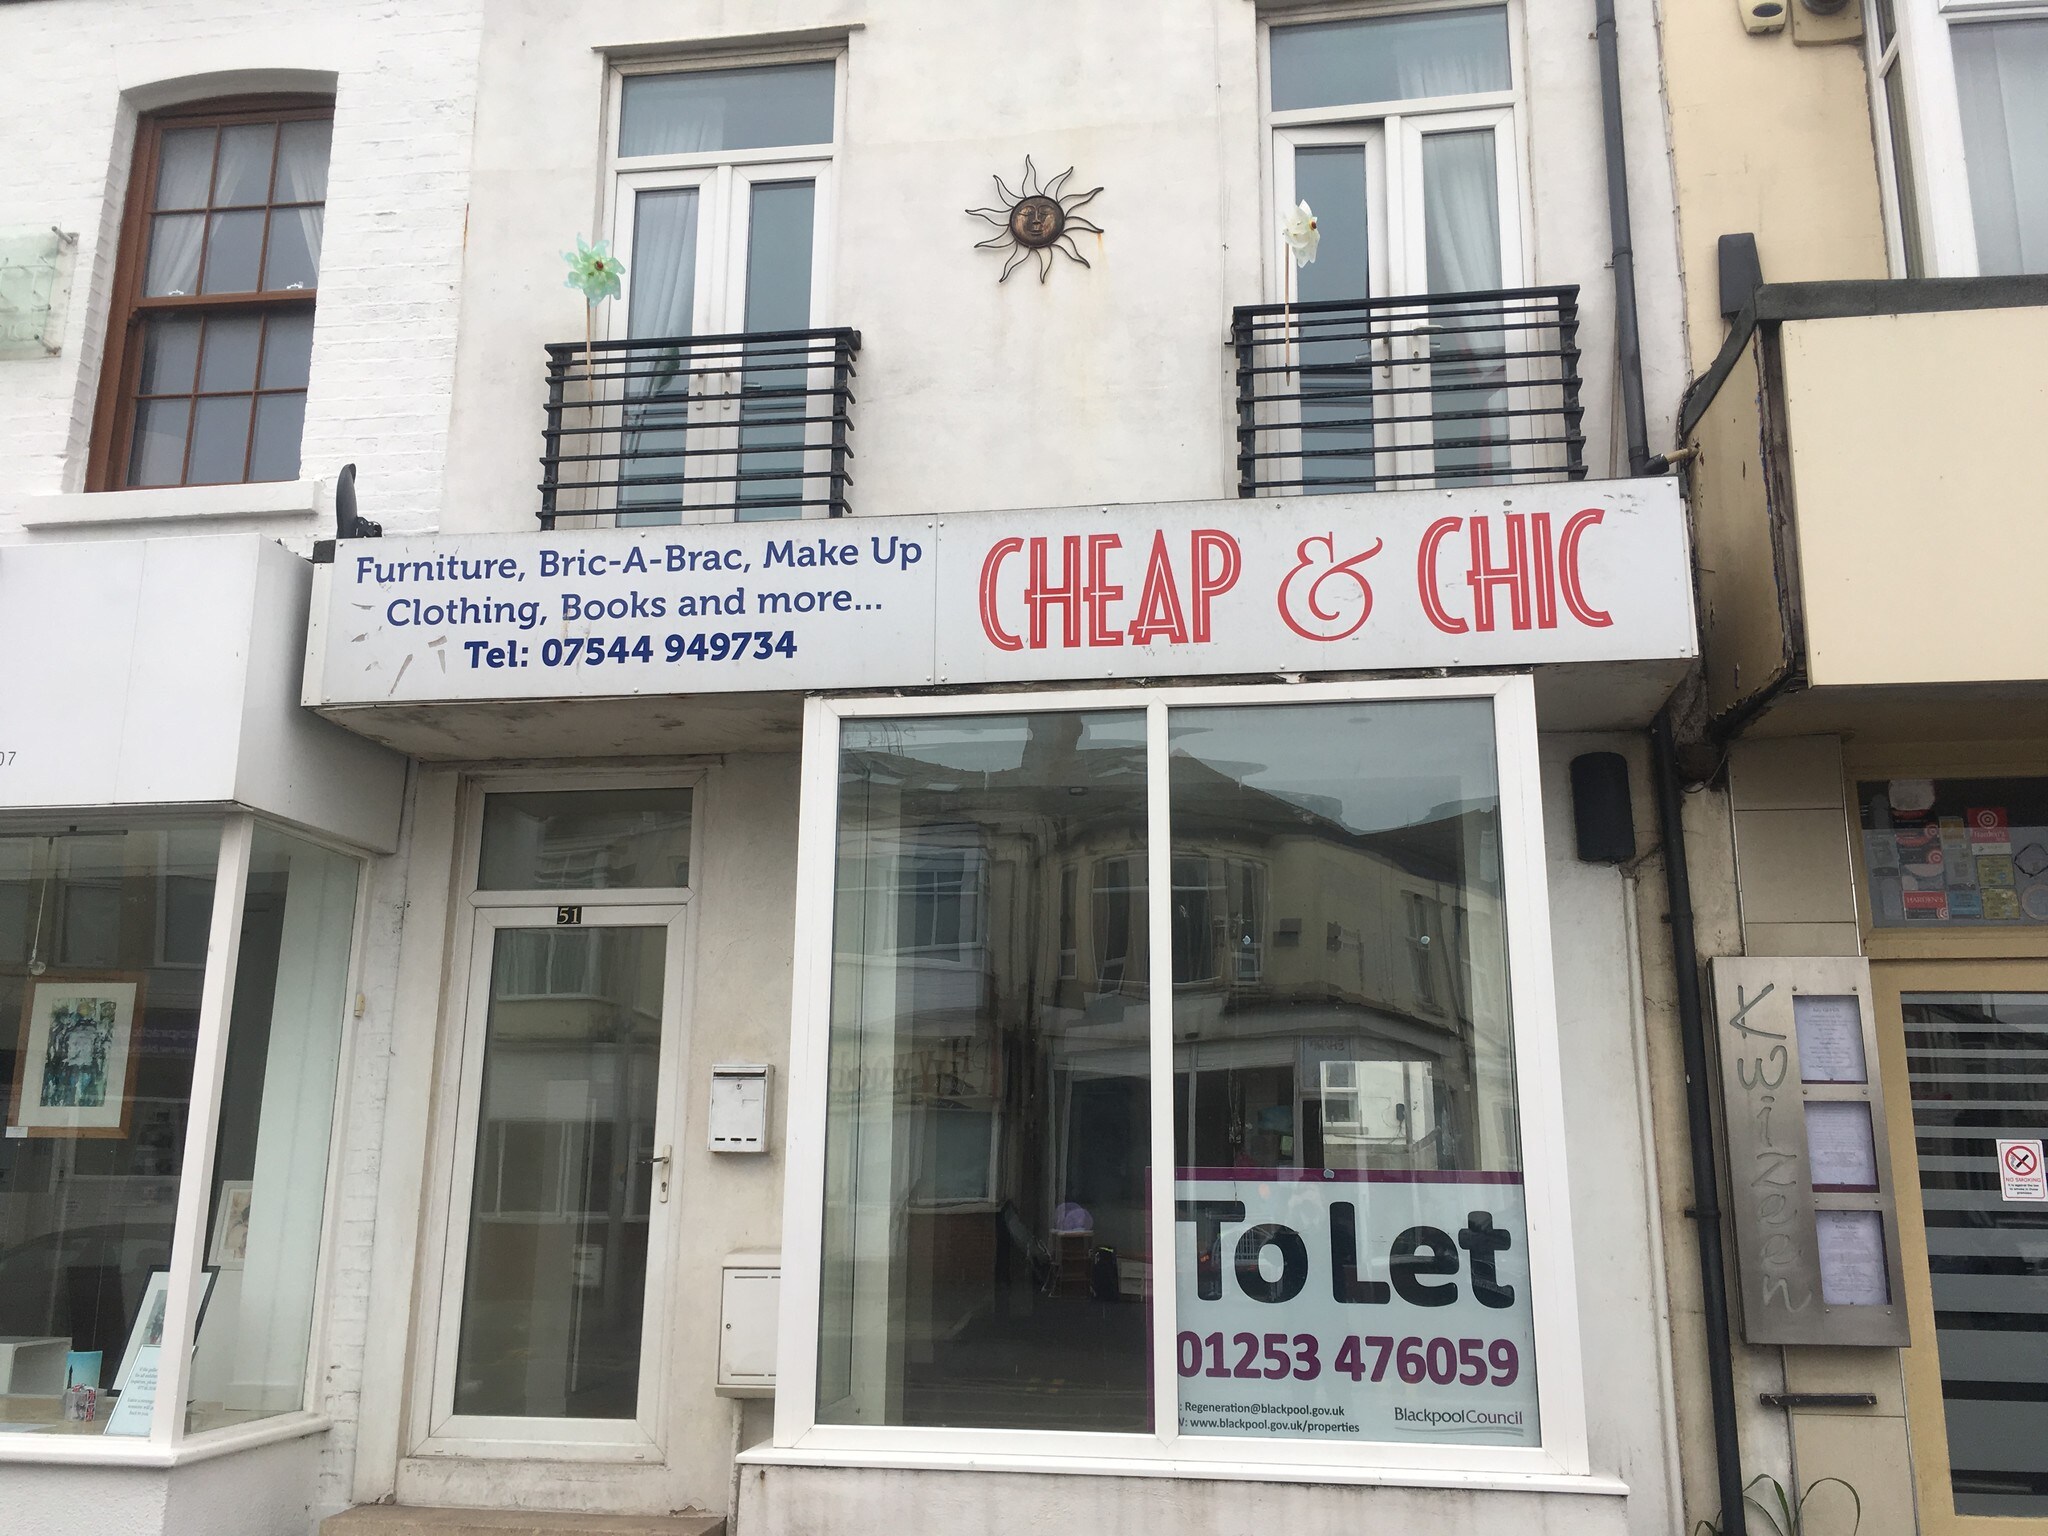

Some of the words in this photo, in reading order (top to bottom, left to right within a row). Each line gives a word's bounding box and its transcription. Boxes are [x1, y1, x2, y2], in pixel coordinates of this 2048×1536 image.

[356, 554, 526, 584] Furniture,
[539, 542, 752, 577] Bric-A-Brac,
[763, 537, 859, 569] Make
[872, 535, 923, 571] Up
[979, 528, 1242, 652] CHEAP
[1277, 531, 1383, 642] &
[1417, 508, 1614, 635] CHIC
[386, 596, 548, 631] Clothing,
[561, 590, 667, 621] Books
[678, 586, 746, 617] and
[464, 639, 529, 669] Tel:
[542, 635, 654, 667] 07544
[665, 630, 798, 663] 949734
[558, 907, 579, 924] 51
[1176, 1200, 1309, 1304] To
[1329, 1201, 1516, 1309] Let
[1178, 1331, 1322, 1381] 01253
[1334, 1335, 1519, 1387] 476059
[1185, 1402, 1345, 1417] Regeneration@blackpool.gov.uk
[1190, 1418, 1360, 1433] www.blackpool.gov.uk/properties
